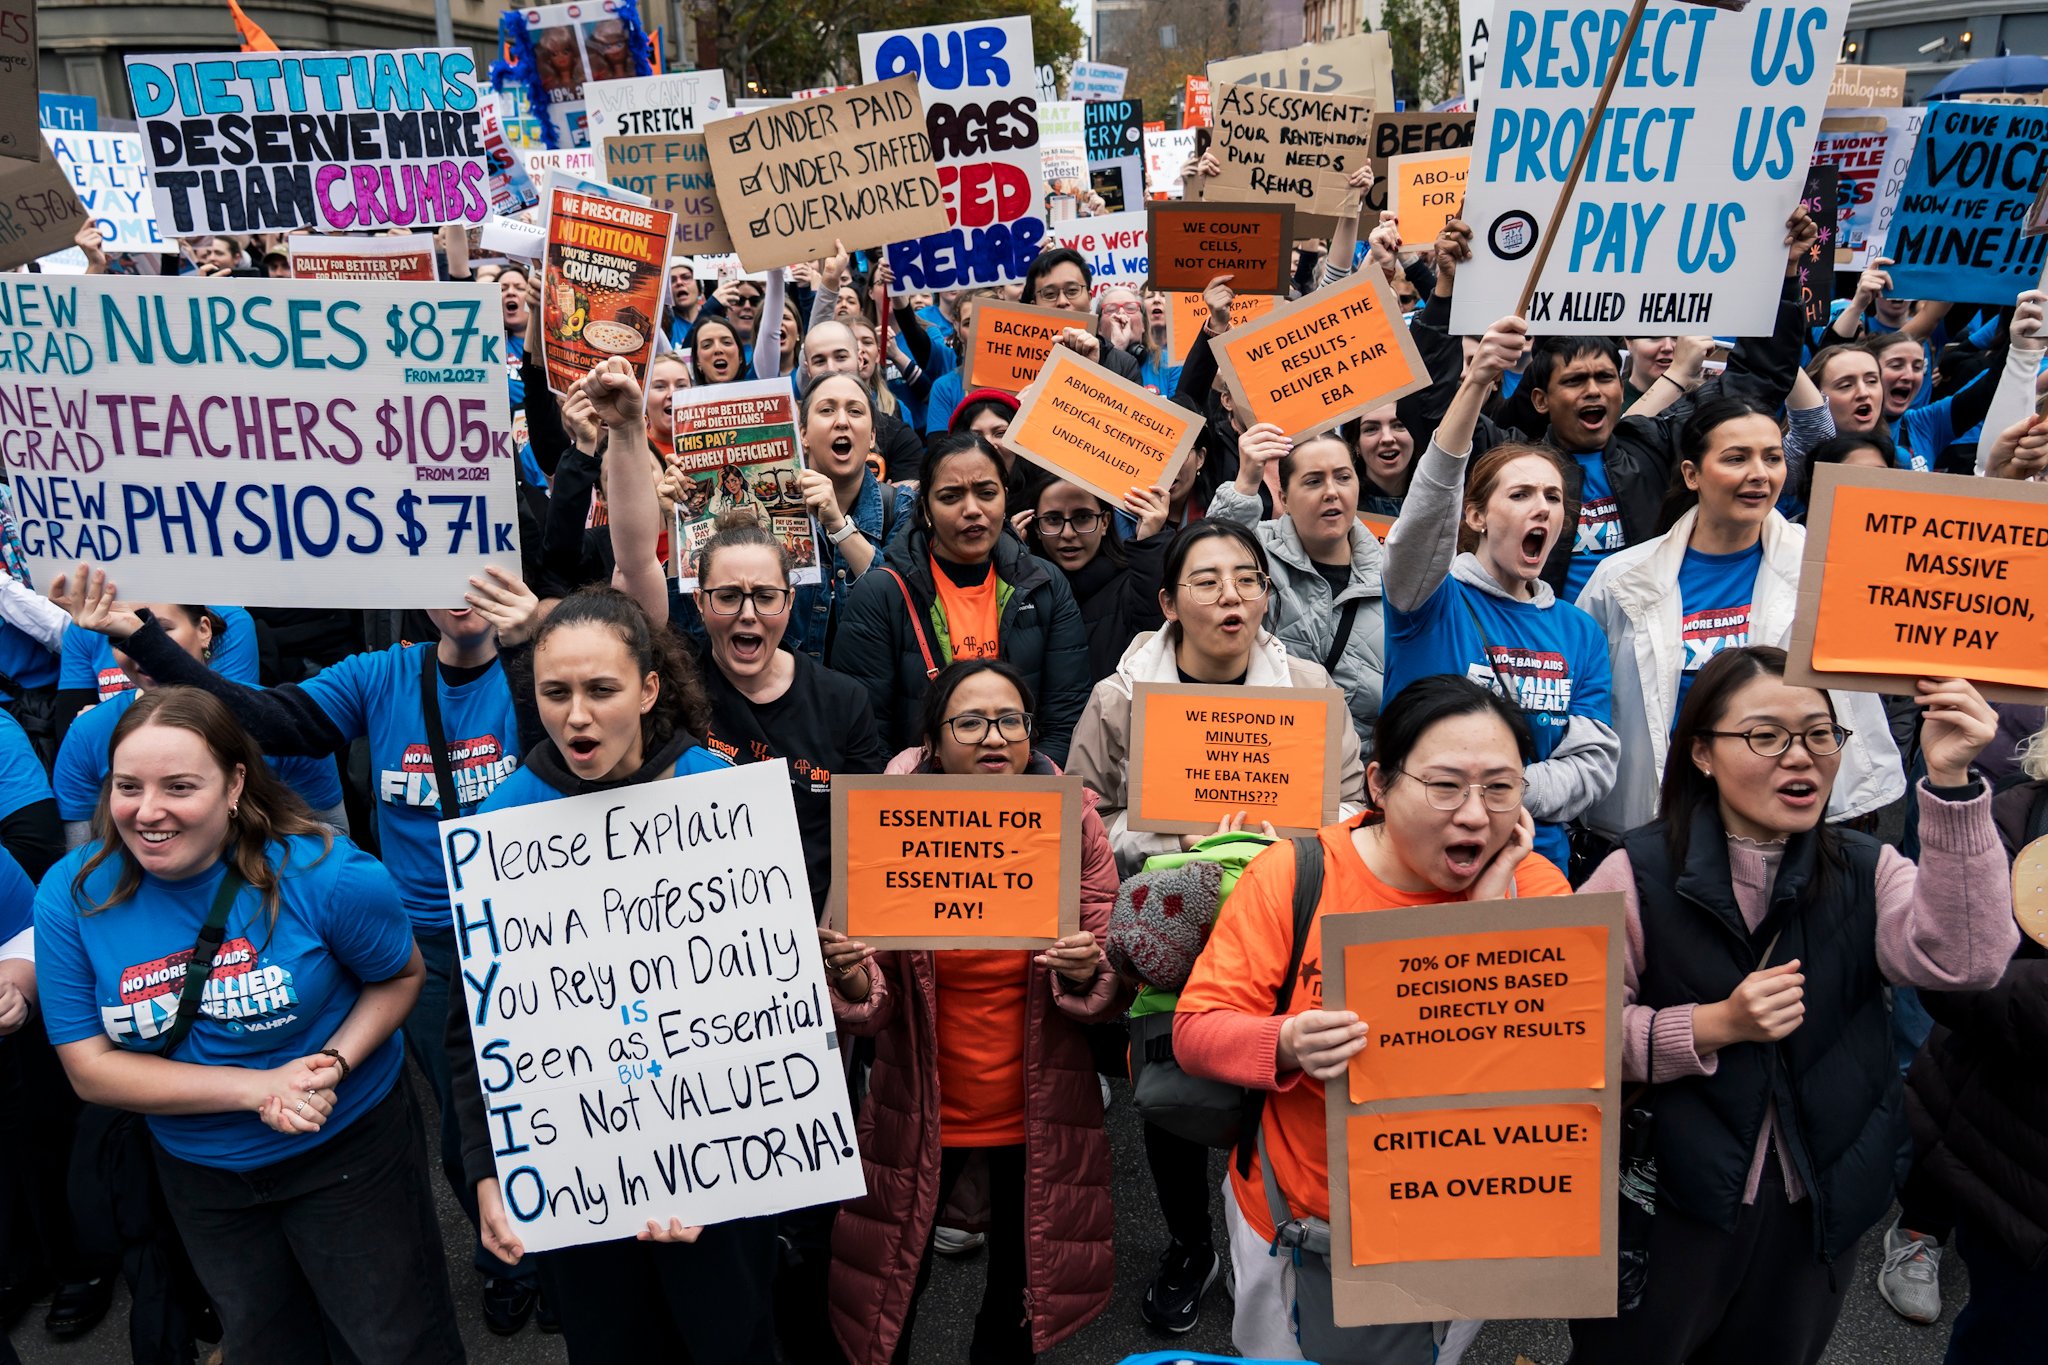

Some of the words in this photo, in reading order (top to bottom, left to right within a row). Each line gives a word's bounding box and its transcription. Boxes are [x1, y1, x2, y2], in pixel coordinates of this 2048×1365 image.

[875, 26, 1012, 91] OUR
[1500, 8, 1717, 89] RESPECT
[1750, 7, 1828, 87] US
[127, 52, 478, 118] DIETITIANS
[645, 78, 700, 108] CAN'T
[1219, 86, 1371, 124] ASSESSMENT:
[618, 106, 694, 136] STRETCH
[755, 104, 839, 151] UNDER
[846, 90, 913, 130] PAID
[1219, 118, 1270, 148] YOUR
[1280, 126, 1368, 147] RENTENTION
[1944, 112, 1999, 137] GIVE
[147, 112, 384, 167] DESERVE
[384, 110, 486, 160] MORE
[1485, 107, 1696, 183] PROTECT
[1732, 106, 1806, 182] US
[1831, 136, 1889, 150] WON'T
[608, 143, 650, 165] NOT
[766, 150, 850, 195] UNDER
[853, 131, 932, 175] STAFFED
[1228, 145, 1266, 165] PLAN
[1285, 150, 1345, 172] NEEDS
[155, 163, 318, 234] THAN
[315, 160, 486, 230] CRUMBS
[611, 175, 657, 195] NOT
[1251, 166, 1314, 199] REHAB
[561, 196, 580, 215] WE
[580, 199, 655, 230] PRESCRIBE
[684, 195, 716, 216] US
[773, 175, 940, 238] OVERWORKED
[1422, 191, 1456, 207] FOR
[1902, 194, 1949, 214] NOW
[1952, 198, 1988, 220] I'VE
[558, 219, 653, 262] NUTRITION,
[1183, 222, 1206, 233] WE
[1209, 222, 1261, 234] COUNT
[1568, 202, 1666, 273] PAY
[1677, 202, 1746, 274] US
[886, 216, 1046, 293] REHAB
[1059, 234, 1096, 252] we
[1199, 240, 1242, 254] CELLS,
[1893, 222, 2047, 278] MINE!!!
[296, 257, 328, 272] RALLY
[330, 259, 345, 270] FOR
[345, 259, 388, 272] BETTER
[389, 256, 419, 271] PAY
[560, 245, 591, 264] YOU'RE
[591, 252, 638, 273] SERVING
[1174, 257, 1205, 269] NOT
[1207, 258, 1268, 270] CHARITY
[562, 259, 631, 291] CRUMBS
[1558, 291, 1626, 322] ALLIED
[1638, 292, 1713, 323] HEALTH
[101, 294, 368, 371] NURSES
[993, 320, 1060, 341] BACKPAY
[1245, 341, 1275, 362] WE
[1275, 312, 1341, 351] DELIVER
[1340, 297, 1373, 321] THE
[986, 340, 1012, 356] THE
[1280, 334, 1348, 374] RESULTS
[404, 368, 442, 383] FROM
[442, 368, 487, 384] 2027
[1269, 366, 1335, 403] DELIVER
[1337, 360, 1350, 375] A
[1350, 342, 1388, 368] FAIR
[0, 384, 89, 430] NEW
[1064, 375, 1129, 416] ABNORMAL
[1130, 409, 1176, 441] RESULT:
[1321, 383, 1355, 406] EBA
[677, 407, 706, 423] RALLY
[707, 406, 720, 416] FOR
[720, 401, 755, 416] BETTER
[756, 399, 780, 413] PAY
[693, 420, 707, 429] FOR
[707, 412, 765, 429] DIETITIANS!
[96, 394, 363, 465] TEACHERS
[677, 435, 704, 452] THIS
[705, 430, 738, 448] PAY?
[1051, 396, 1102, 431] MEDICAL
[1102, 423, 1166, 463] SCIENTISTS
[2, 427, 104, 474] GRAD
[680, 449, 725, 472] SEVERELY
[725, 440, 790, 464] DEFICIENT!
[1051, 424, 1142, 478] UNDERVALUED!
[415, 467, 456, 481] FROM
[457, 467, 491, 481] 2029
[14, 475, 106, 521] NEW
[122, 480, 384, 560] PHYSIOS
[692, 522, 709, 533] FAIR
[694, 528, 711, 540] PAY
[1864, 512, 1918, 536] MTP
[1922, 518, 2048, 548] ACTIVATED
[20, 519, 122, 562] GRAD
[1905, 552, 2009, 580] MASSIVE
[1867, 584, 2036, 622] TRANSFUSION,
[1683, 614, 1713, 632] MORE
[1714, 613, 1745, 629] BAND
[1894, 623, 1948, 646] TINY
[1952, 628, 2000, 650] PAY
[1516, 656, 1542, 670] BAND
[1543, 659, 1564, 672] AIDS
[1185, 709, 1208, 722] WE
[1211, 711, 1276, 726] RESPOND
[1279, 714, 1295, 726] IN
[471, 743, 496, 758] AIDS
[707, 737, 739, 758] msav
[1205, 730, 1273, 746] MINUTES,
[404, 753, 421, 765] NO
[1206, 749, 1240, 762] WHY
[1242, 751, 1271, 764] HAS
[810, 766, 830, 785] ahp
[1185, 768, 1211, 780] THE
[1214, 769, 1241, 782] EBA
[1245, 771, 1290, 785] TAKEN
[1194, 787, 1279, 804] MONTHS???
[879, 809, 993, 829] ESSENTIAL
[998, 810, 1043, 829] FOR
[445, 825, 592, 893] Please
[605, 801, 754, 861] Explain
[901, 840, 1006, 859] PATIENTS
[885, 870, 998, 889] ESSENTIAL
[1003, 872, 1034, 890] TO
[603, 865, 793, 936] Profession
[934, 901, 984, 920] PAY!
[549, 960, 616, 1010] Rely
[629, 953, 679, 995] on
[687, 926, 803, 984] Daily
[1399, 956, 1440, 974] 70%
[1444, 953, 1471, 970] OF
[1475, 946, 1567, 967] MEDICAL
[122, 977, 144, 994] NO
[145, 962, 188, 987] MORE
[202, 964, 285, 1002] ALLIED
[1396, 976, 1499, 999] DECISIONS
[1504, 971, 1569, 990] BASED
[244, 1013, 298, 1033] VAHPA
[1419, 1000, 1508, 1021] DIRECTLY
[1514, 998, 1545, 1013] ON
[480, 1037, 594, 1094] Seen
[607, 1031, 650, 1063] as
[658, 982, 825, 1060] Essential
[1379, 1024, 1498, 1049] PATHOLOGY
[1503, 1020, 1587, 1039] RESULTS
[578, 1083, 641, 1140] Not
[650, 1051, 821, 1121] VALUED
[1373, 1127, 1487, 1152] CRITICAL
[1493, 1123, 1588, 1145] VALUE:
[505, 1165, 610, 1226] Only
[617, 1155, 650, 1207] In
[653, 1110, 856, 1197] VICTORIA!
[1389, 1180, 1440, 1201] EBA
[1445, 1174, 1573, 1197] OVERDUE
